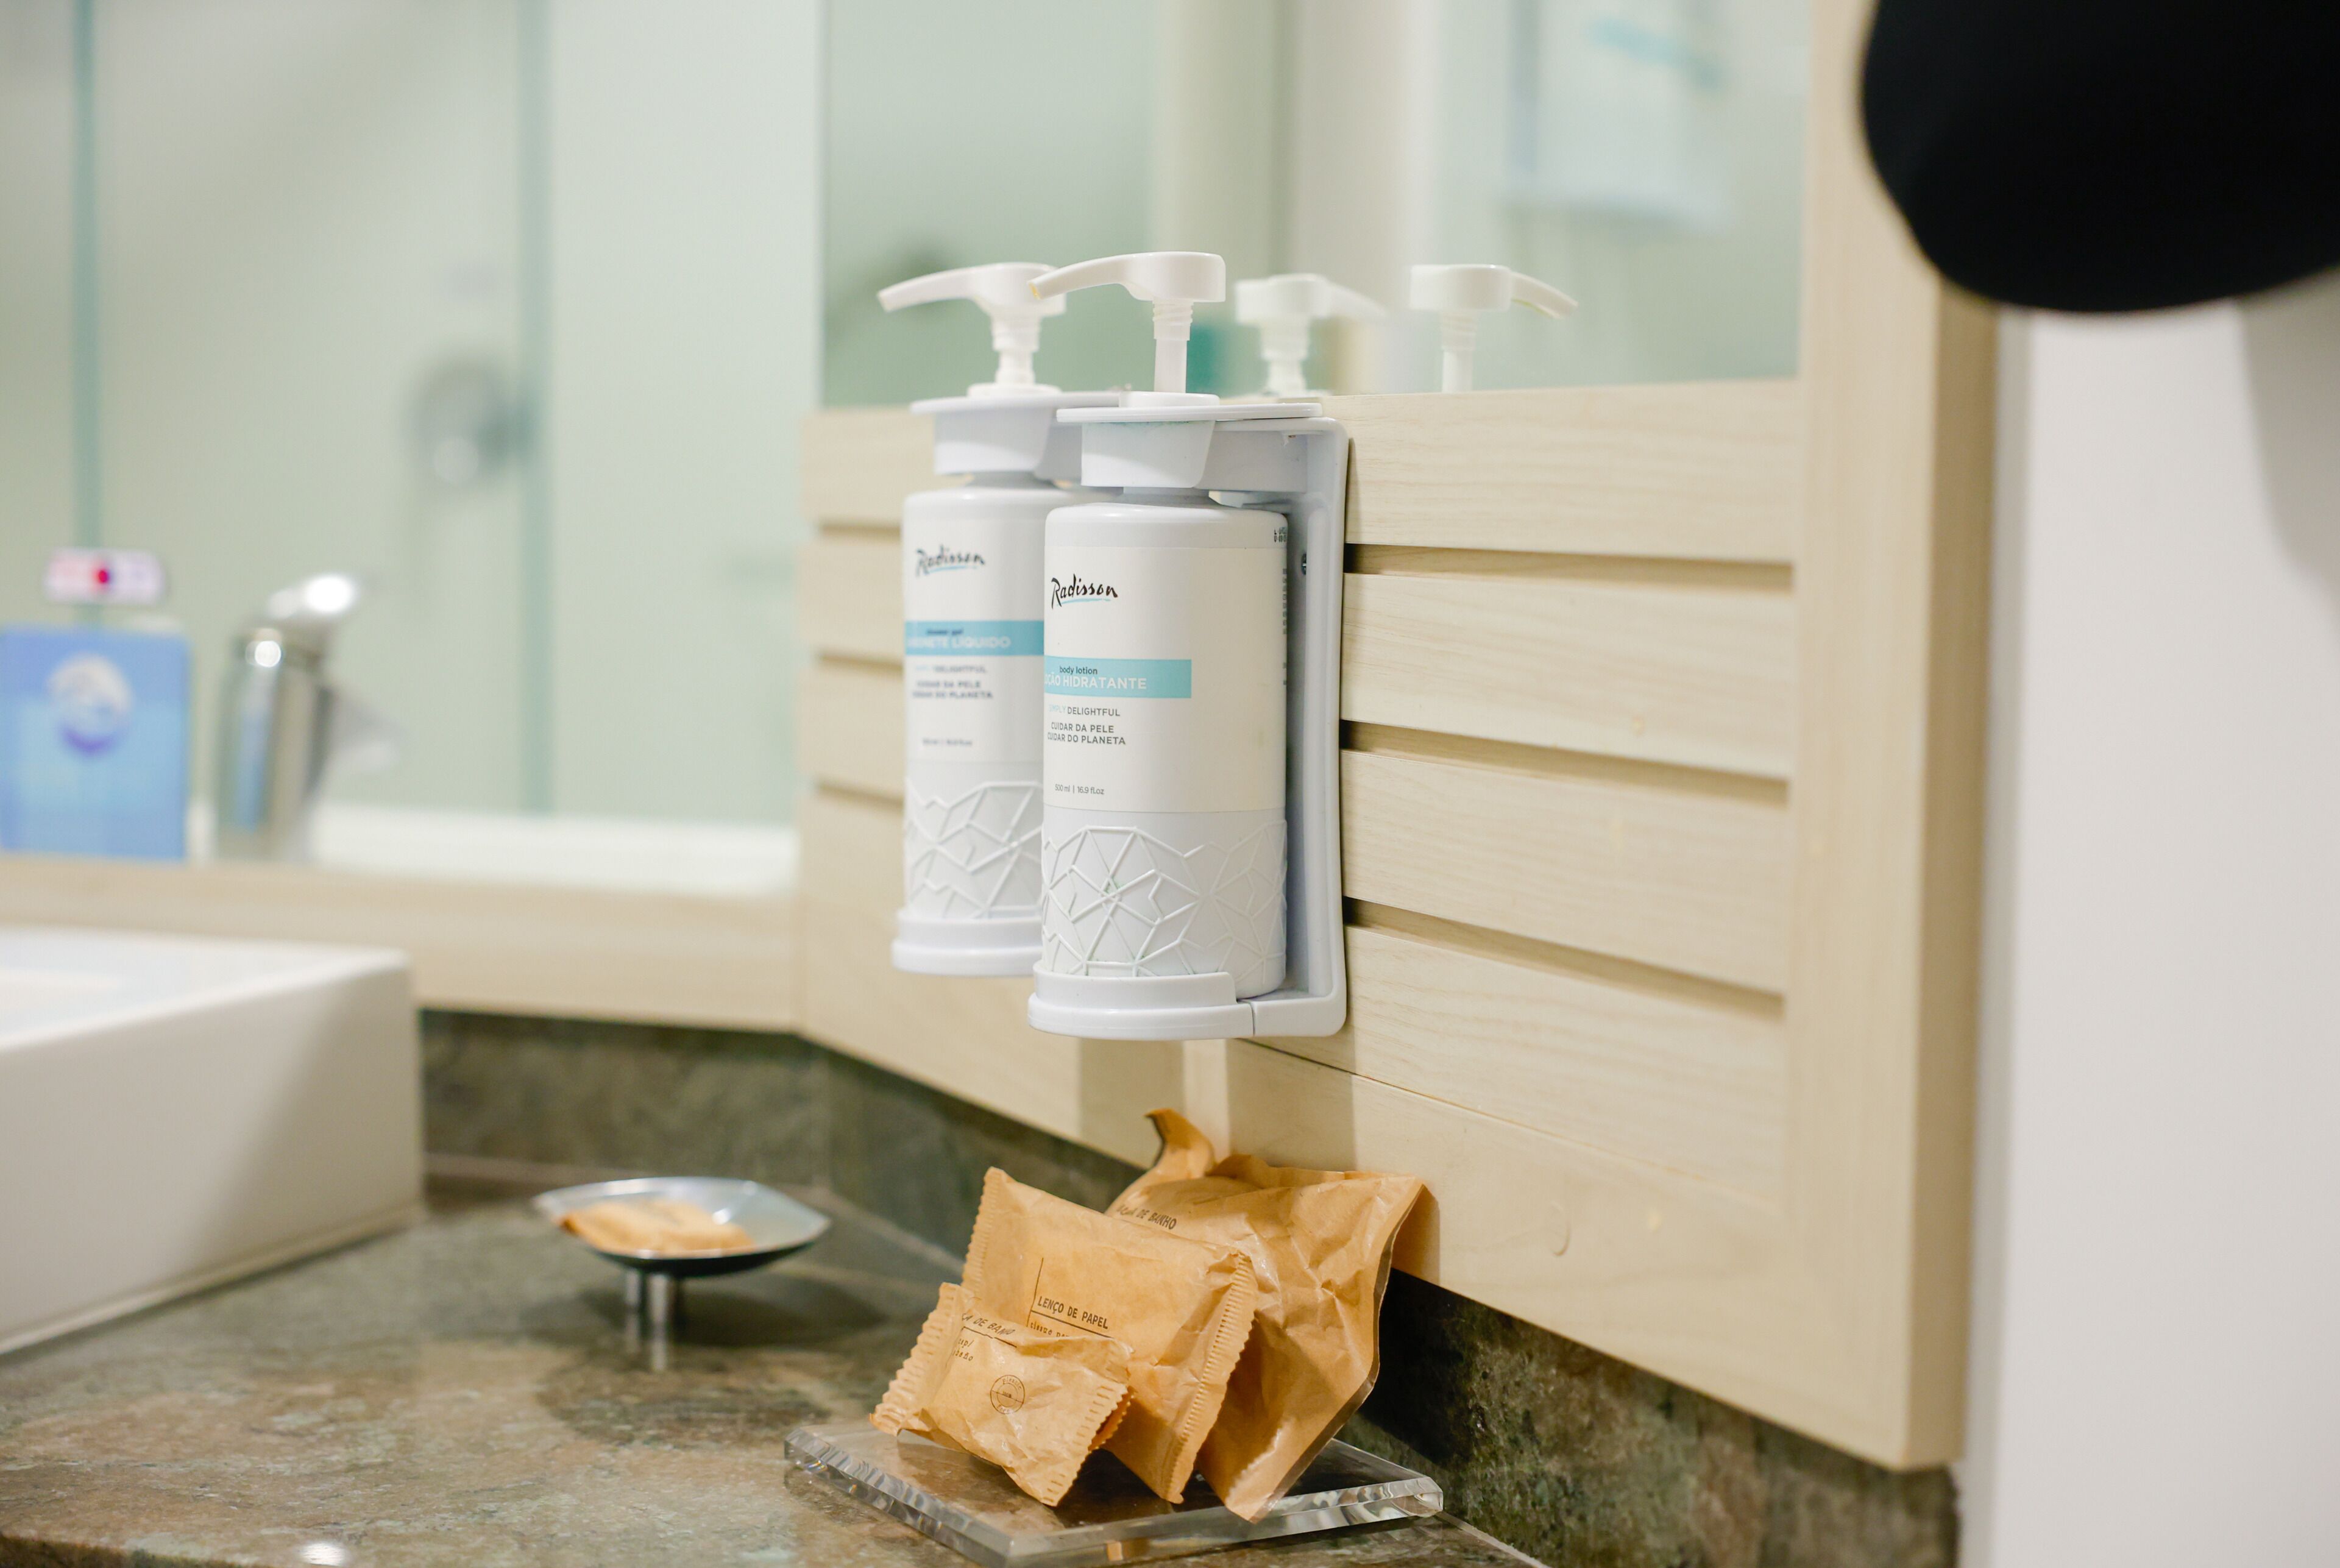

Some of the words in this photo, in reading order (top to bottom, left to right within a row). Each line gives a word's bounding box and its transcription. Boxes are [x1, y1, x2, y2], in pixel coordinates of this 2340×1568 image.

[1051, 573, 1118, 609] Radisson
[1059, 666, 1074, 675] body
[1063, 675, 1147, 690] HIDRATANTE
[1067, 706, 1120, 717] DELIGHTFUL
[1051, 722, 1073, 732] CUIDAR
[1076, 723, 1087, 732] DA
[1090, 725, 1115, 733] PELE
[1067, 734, 1079, 743] DO
[1081, 735, 1126, 745] PLANETA
[1148, 1212, 1177, 1230] BANHO
[1038, 1296, 1065, 1314] LENÇO
[1067, 1306, 1078, 1318] DE
[1082, 1311, 1108, 1330] PAPEL
[973, 1318, 988, 1327] DE
